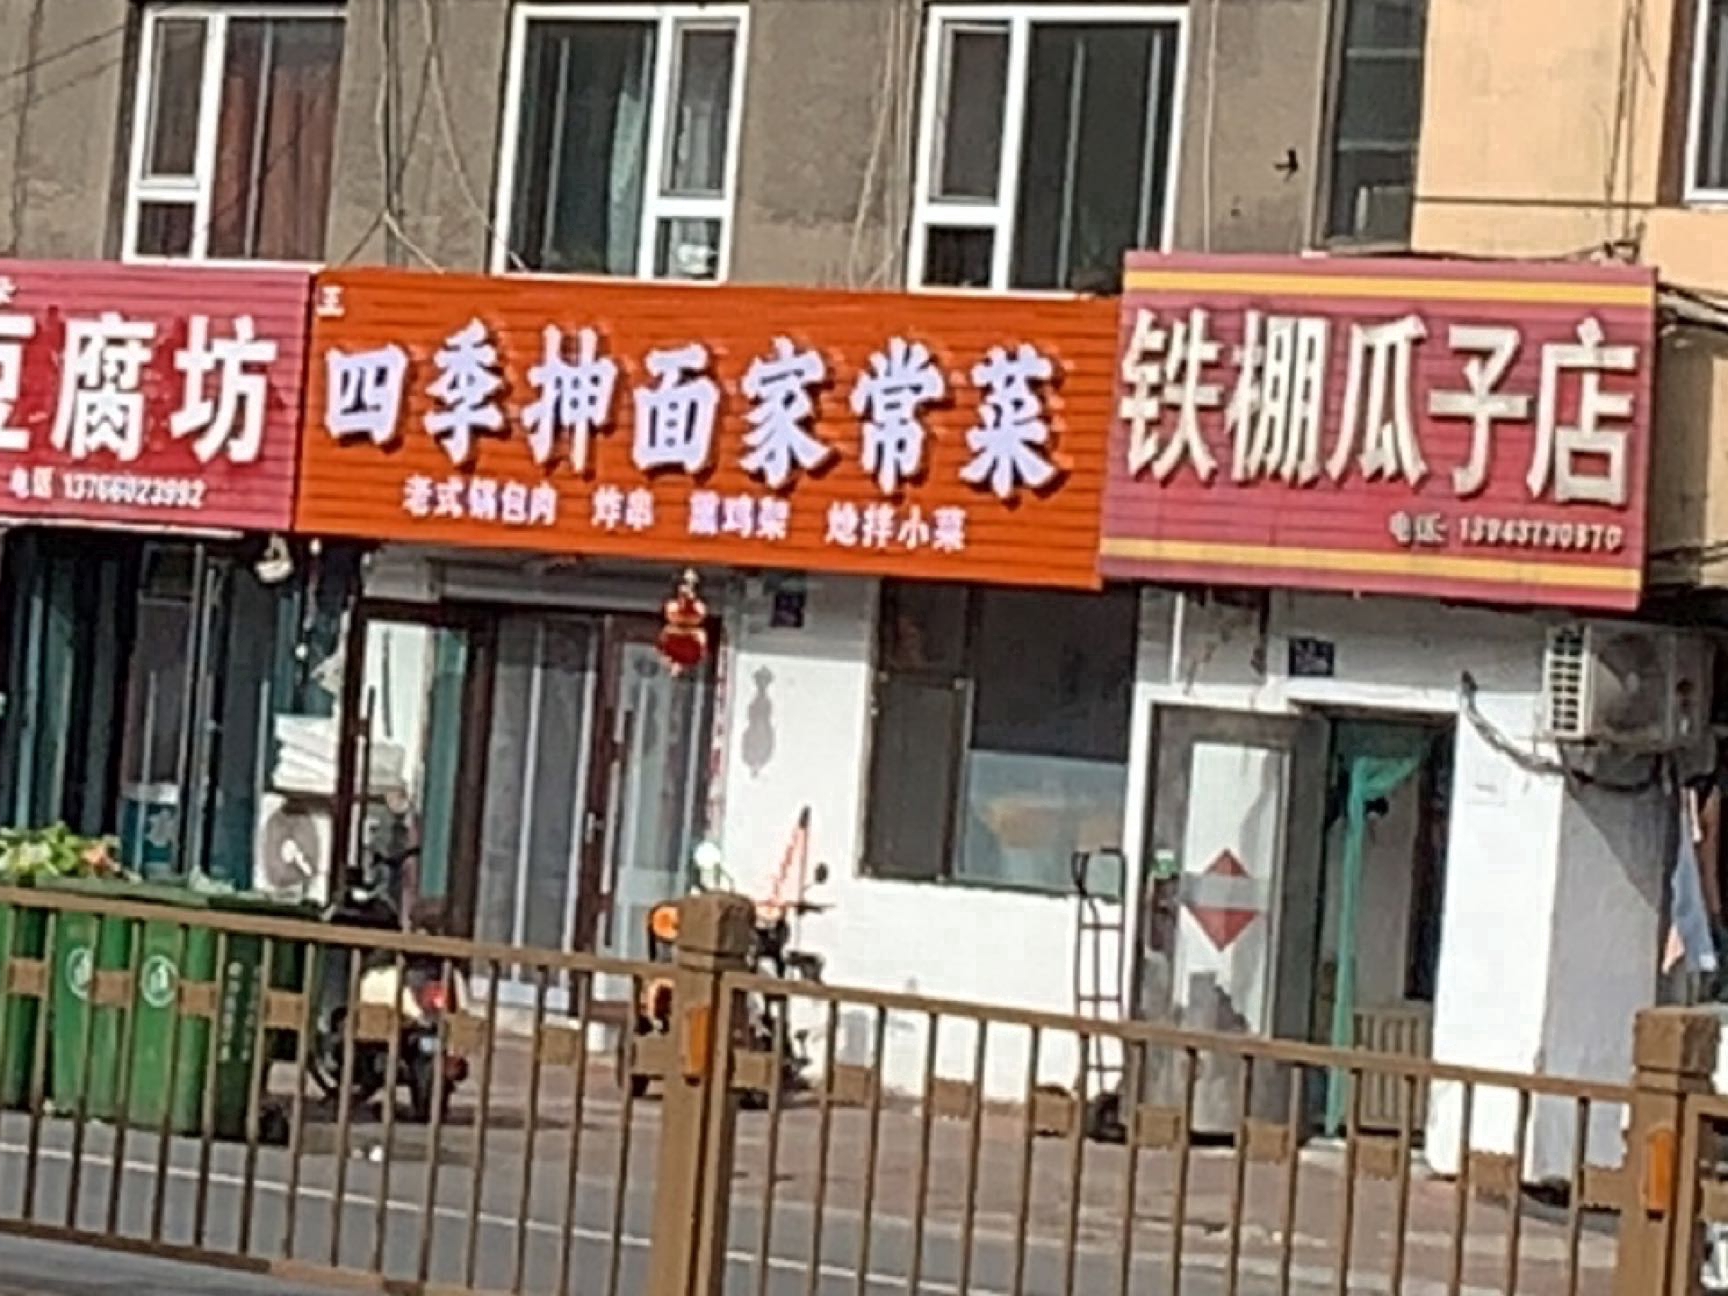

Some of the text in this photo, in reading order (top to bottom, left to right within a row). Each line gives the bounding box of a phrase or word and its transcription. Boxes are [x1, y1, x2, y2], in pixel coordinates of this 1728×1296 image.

[324, 317, 1061, 500] 四季抻面家常菜
[1118, 306, 1639, 505] 铁棚瓜子店
[402, 474, 558, 526] 老式锅包肉
